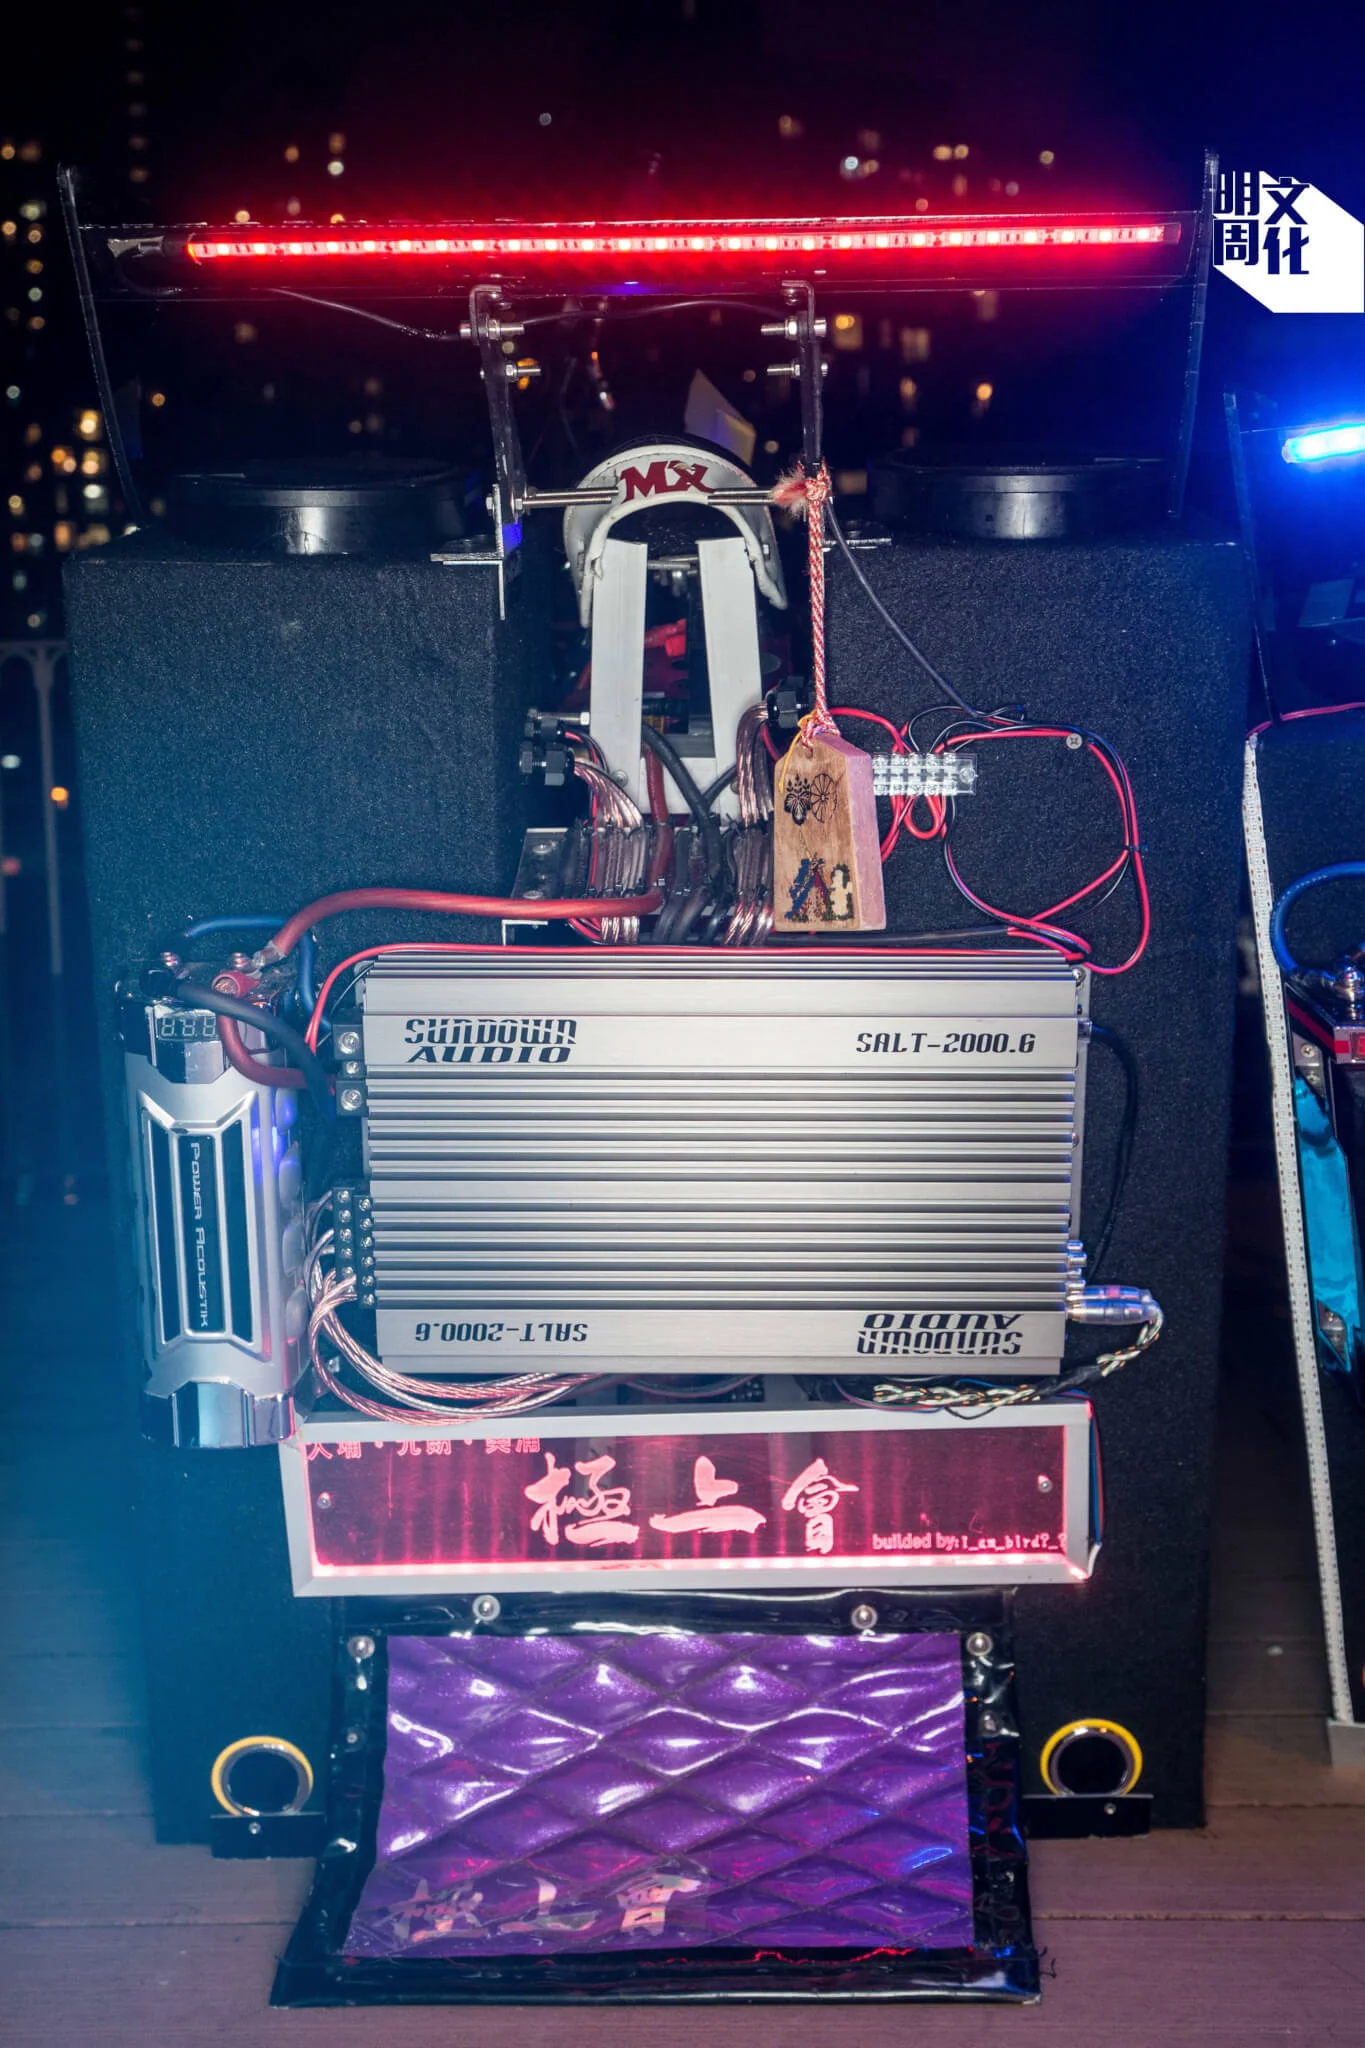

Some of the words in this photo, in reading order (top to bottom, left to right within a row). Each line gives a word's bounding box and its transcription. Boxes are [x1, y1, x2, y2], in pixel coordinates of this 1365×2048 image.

[620, 460, 716, 504] MX
[856, 1032, 1036, 1053] SALT-2000.6
[406, 1046, 571, 1063] AUDIO
[190, 1142, 203, 1222] POWER
[863, 1313, 1023, 1329] AUDIO
[415, 1322, 588, 1342] SALT-2000.6
[872, 1533, 931, 1550] builded
